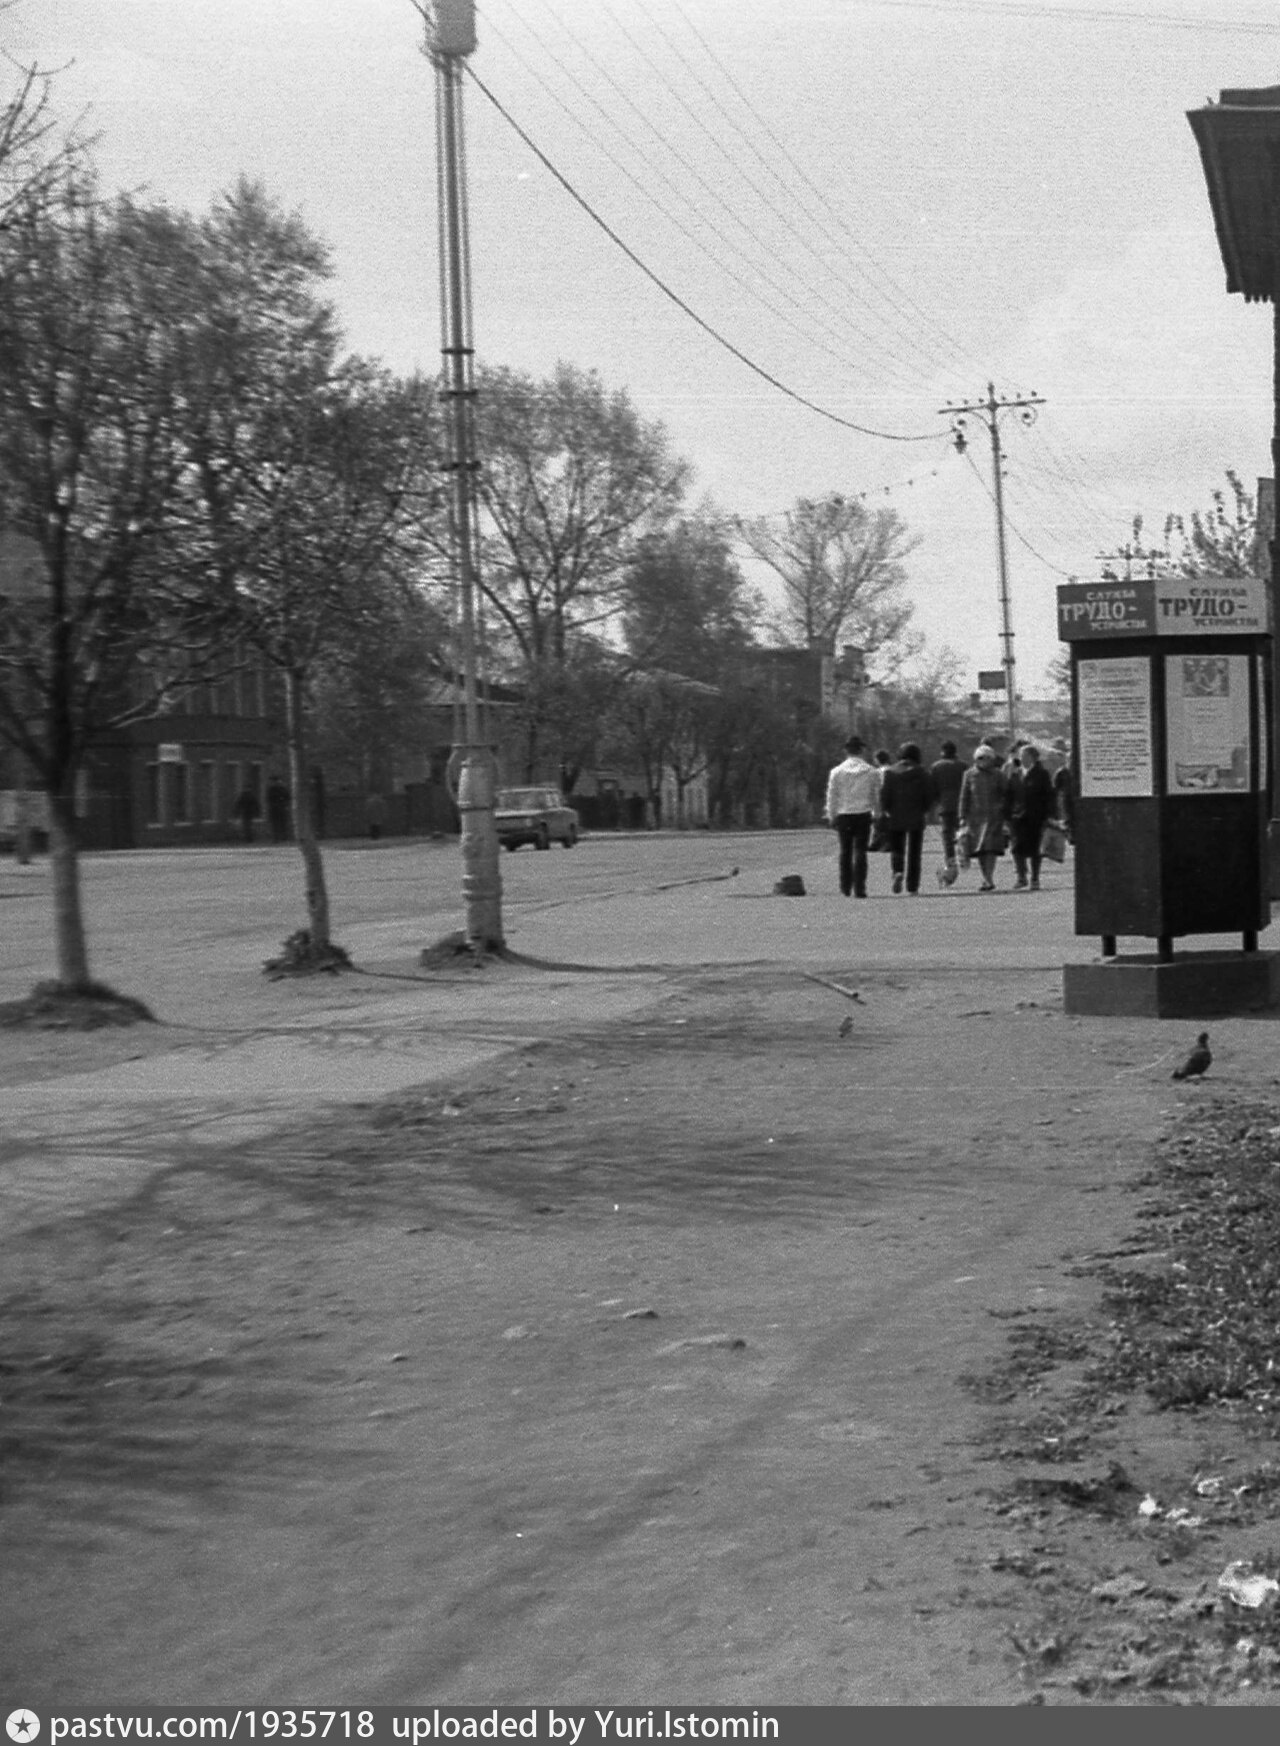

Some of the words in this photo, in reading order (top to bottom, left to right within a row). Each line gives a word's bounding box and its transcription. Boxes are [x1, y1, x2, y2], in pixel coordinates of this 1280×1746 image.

[1086, 589, 1137, 601] СЛУЖБА
[1189, 587, 1247, 597] СЛУЖБА
[1059, 600, 1138, 622] ТРУДО-
[1158, 597, 1248, 617] ТРУДО-
